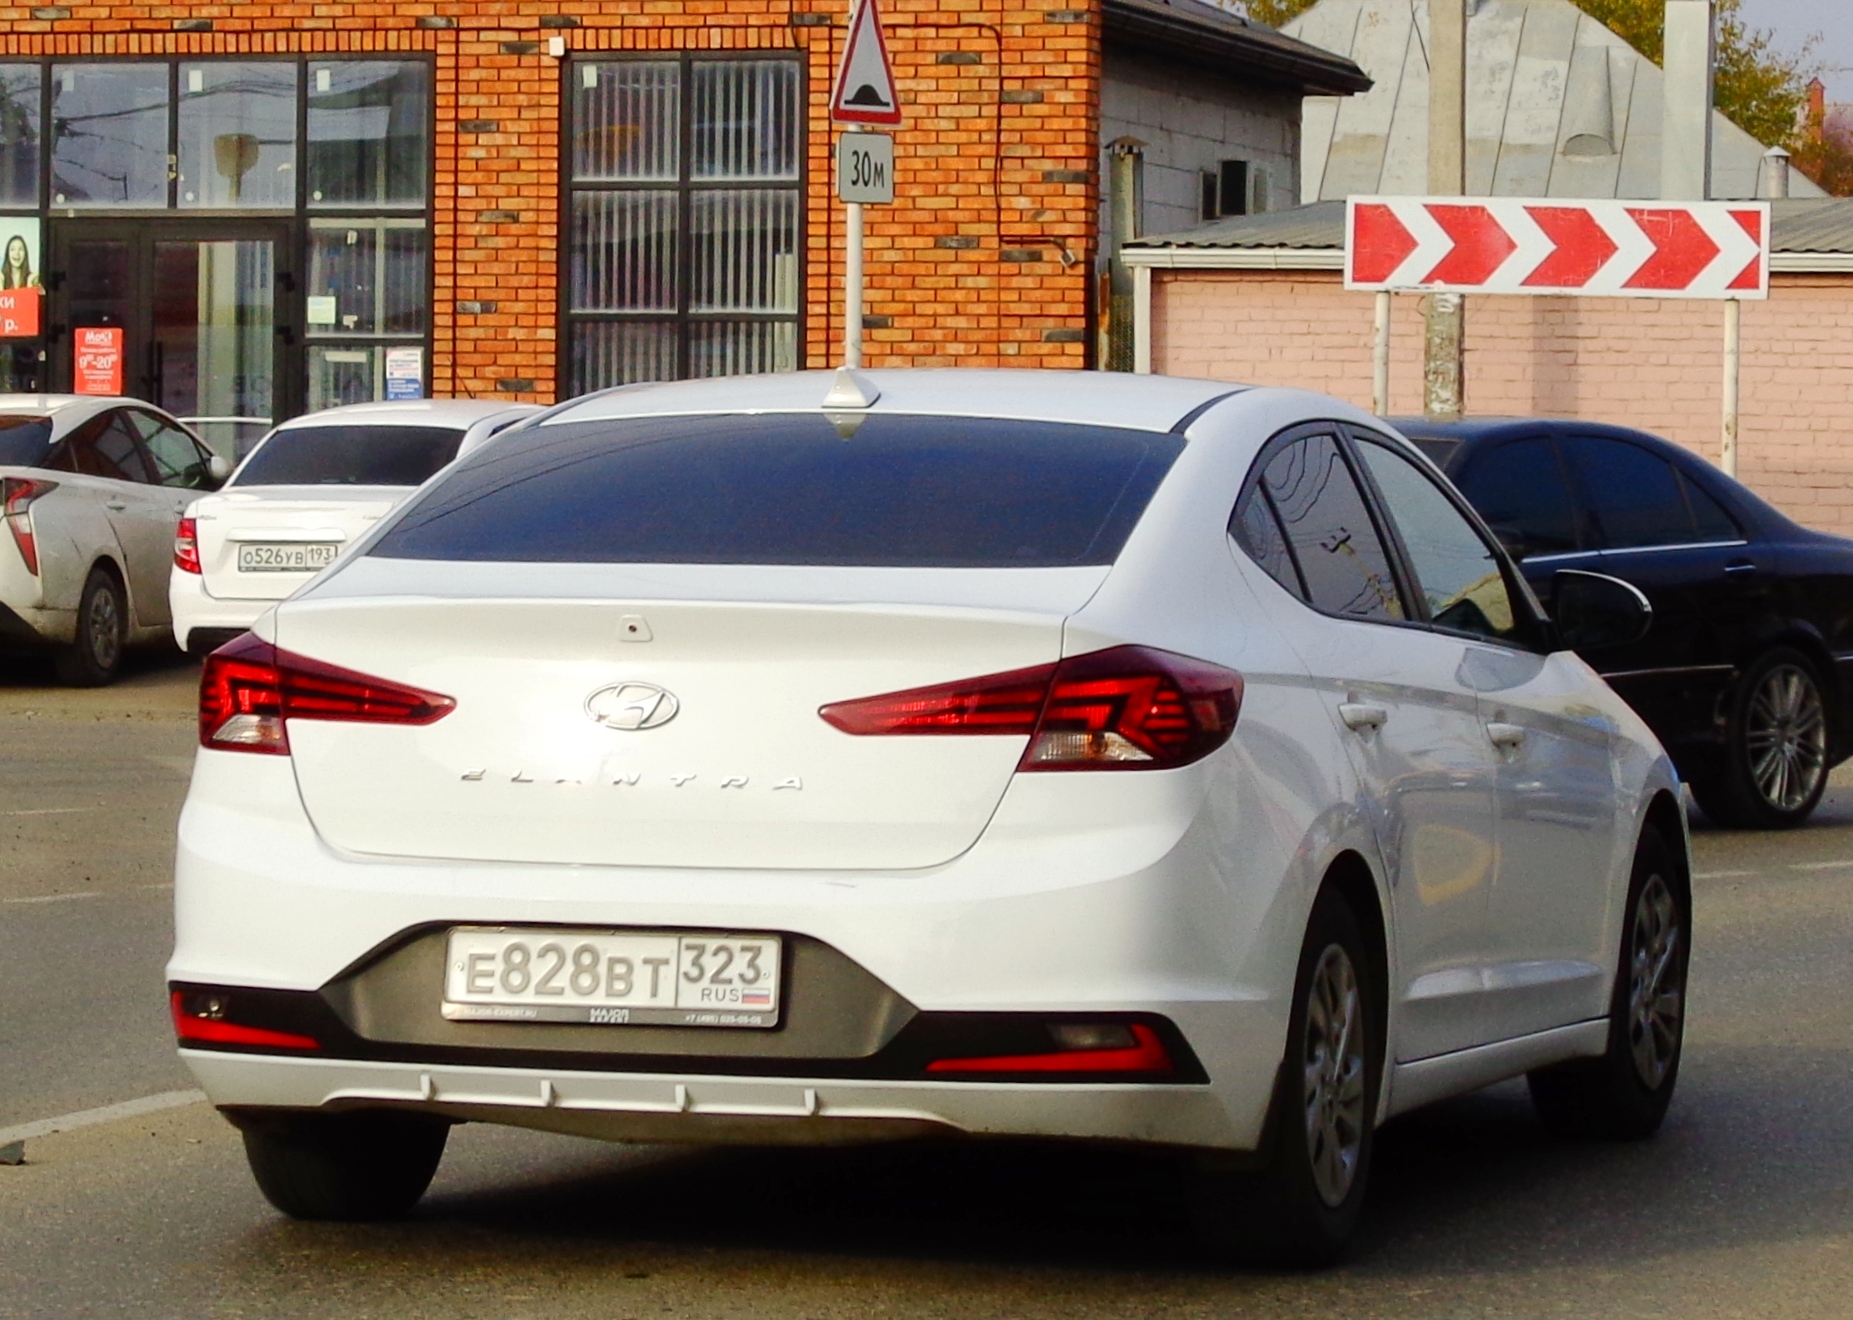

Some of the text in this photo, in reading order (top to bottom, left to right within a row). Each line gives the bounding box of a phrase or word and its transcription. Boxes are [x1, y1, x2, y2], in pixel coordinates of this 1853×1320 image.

[308, 548, 331, 563] 193
[466, 941, 763, 999] Е828ВТ 323
[701, 988, 740, 1002] RUS
